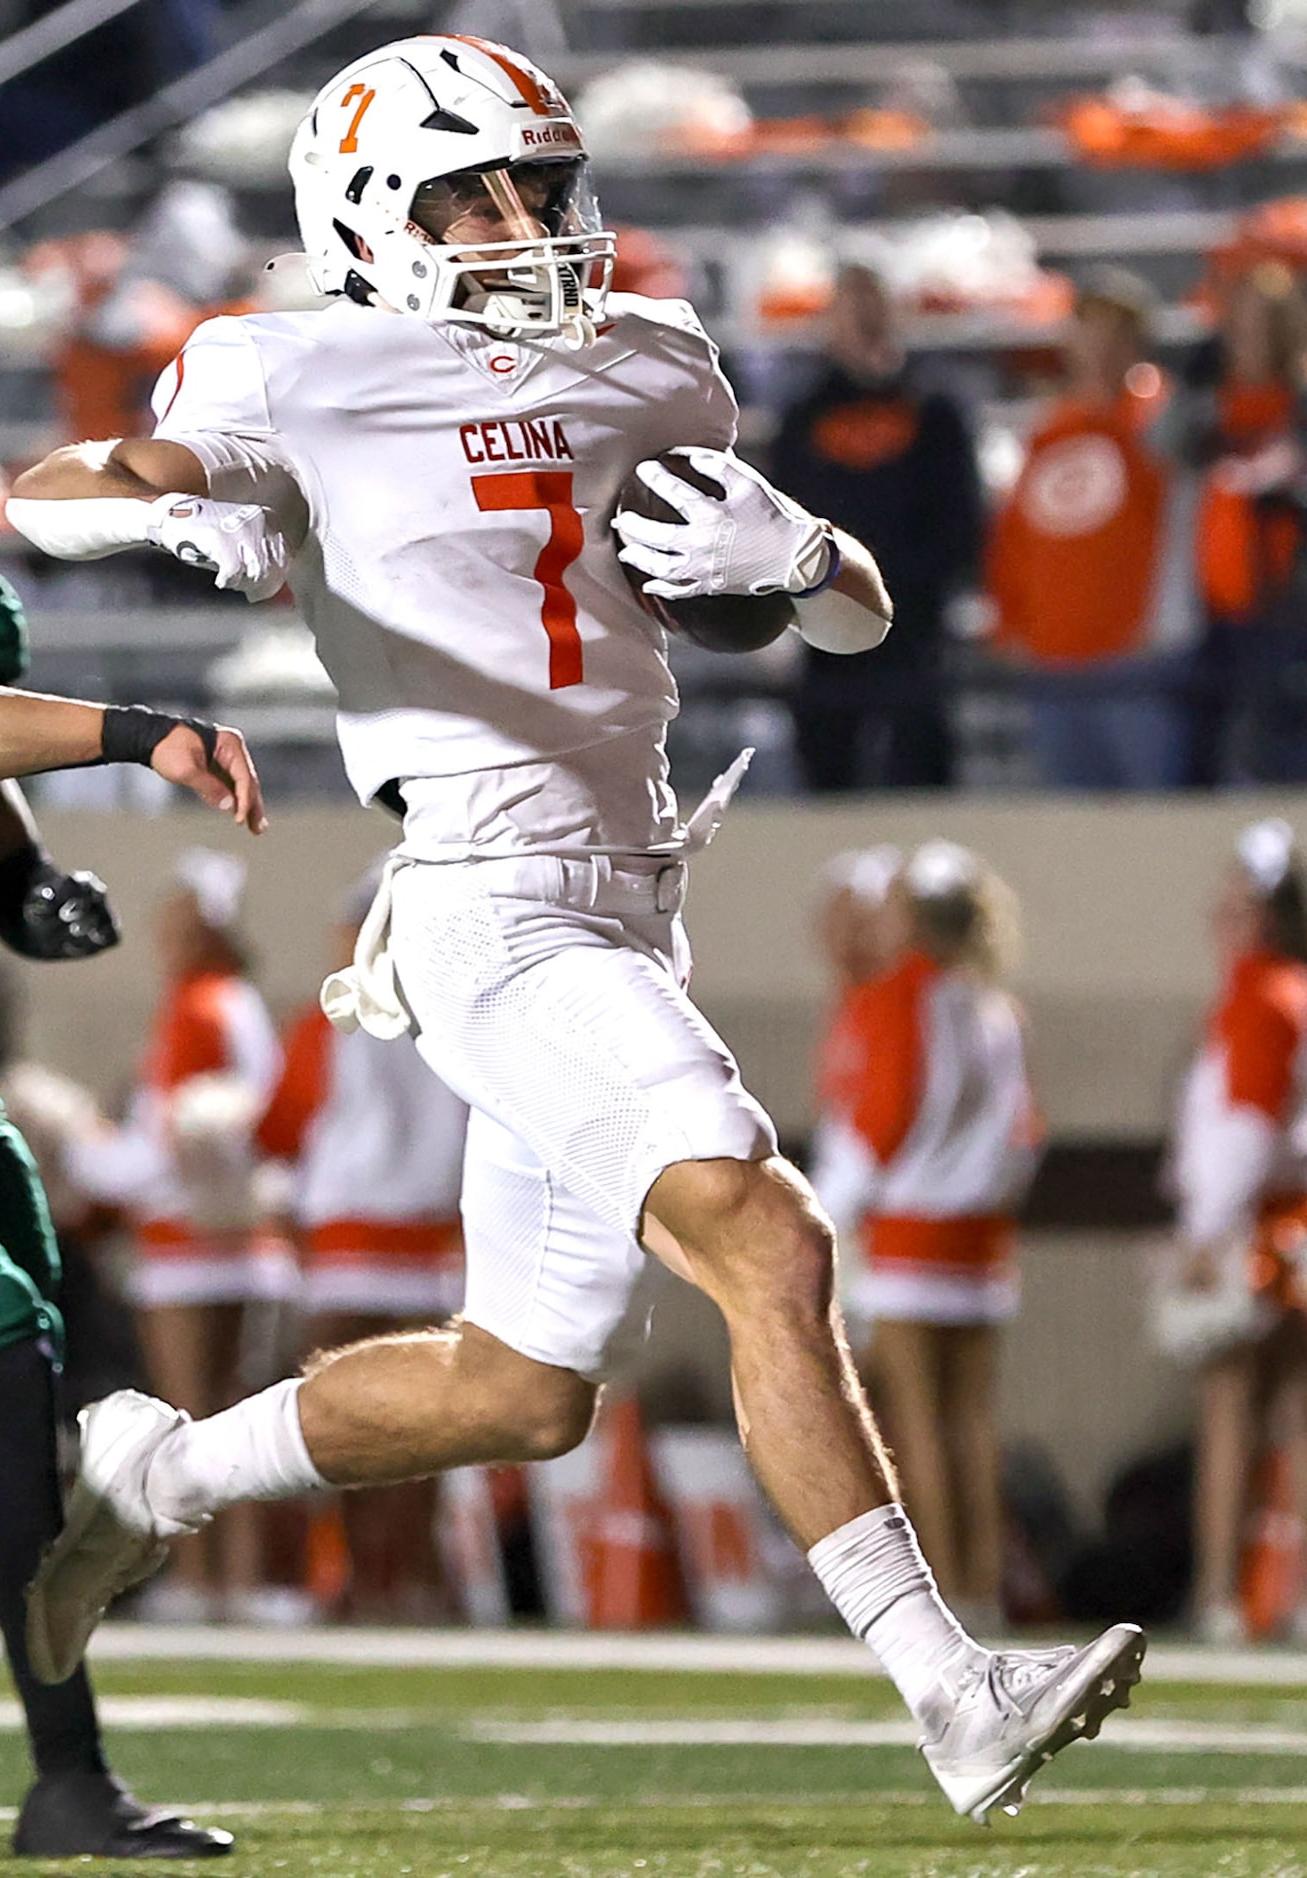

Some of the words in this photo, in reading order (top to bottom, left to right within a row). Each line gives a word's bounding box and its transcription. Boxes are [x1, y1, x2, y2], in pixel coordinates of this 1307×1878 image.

[339, 83, 375, 153] 7
[490, 355, 517, 373] C
[459, 421, 575, 463] CELINA
[471, 471, 585, 690] 7
